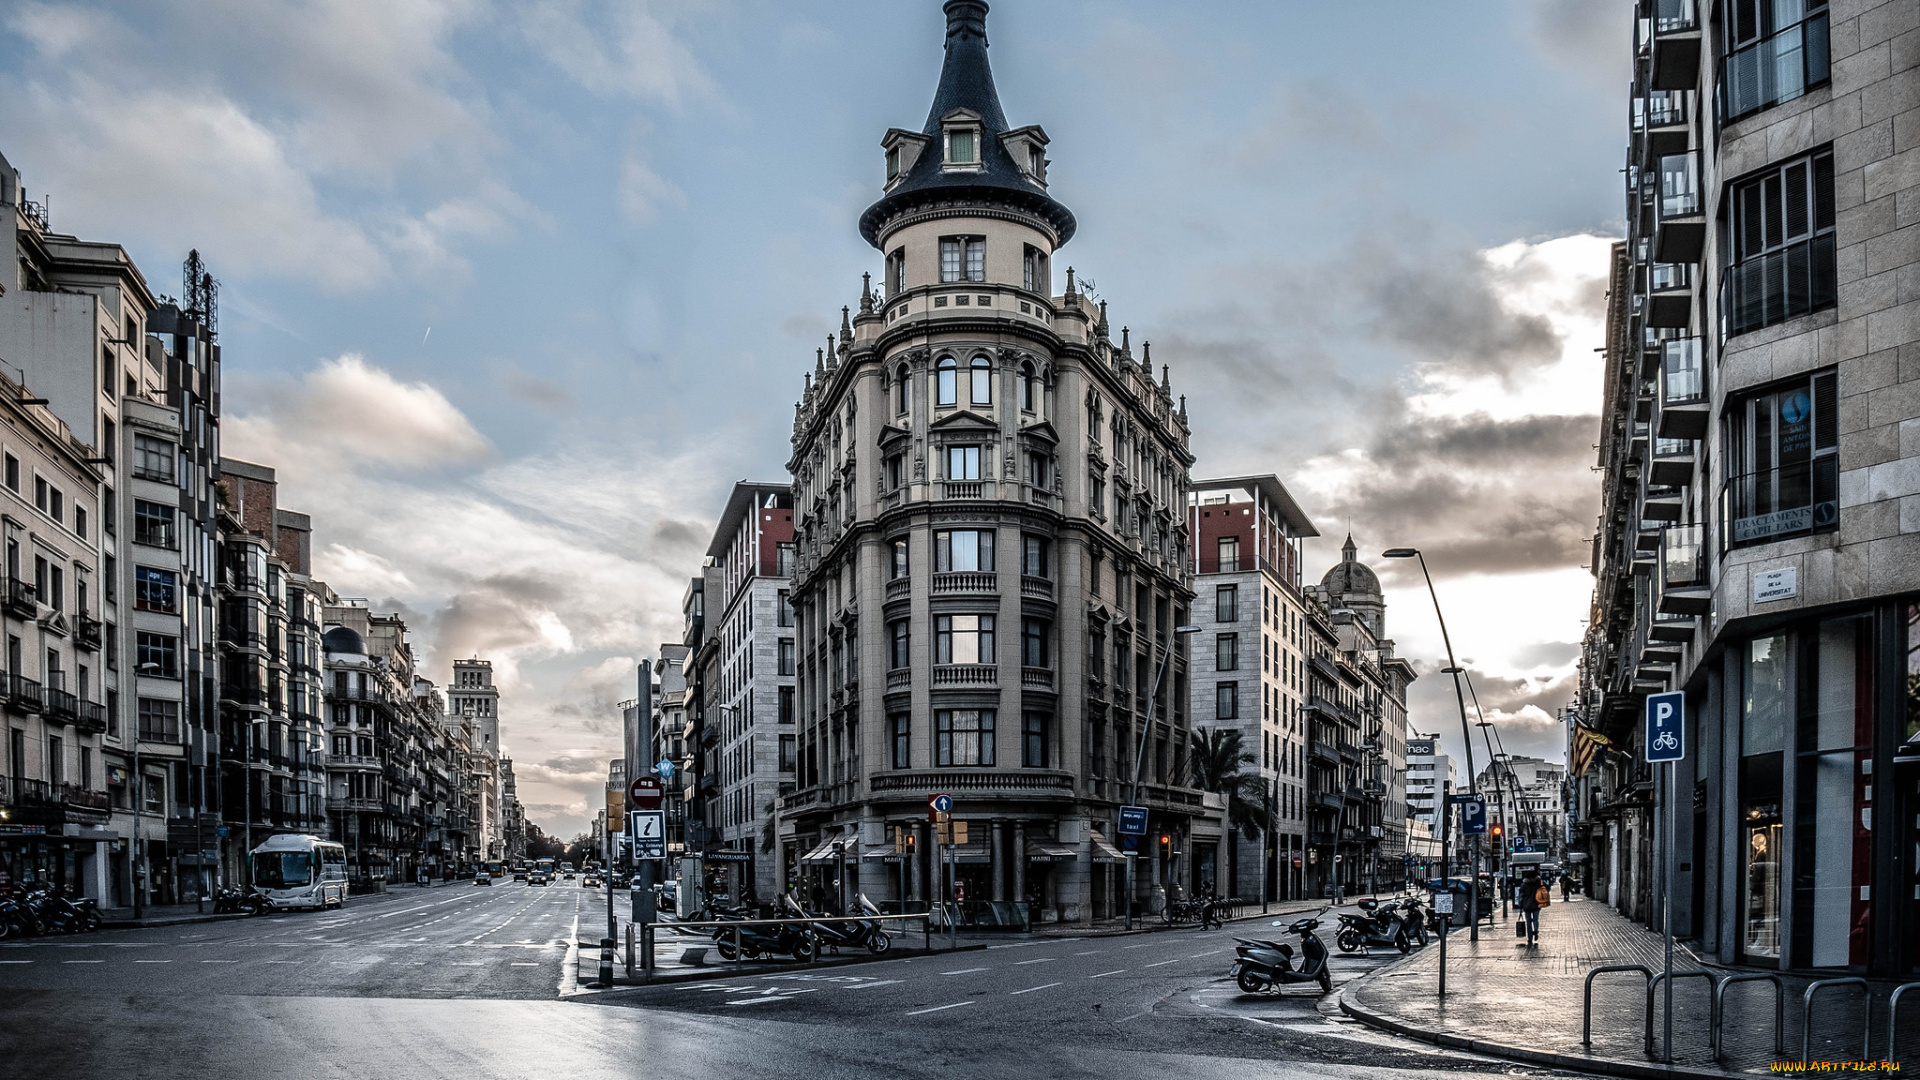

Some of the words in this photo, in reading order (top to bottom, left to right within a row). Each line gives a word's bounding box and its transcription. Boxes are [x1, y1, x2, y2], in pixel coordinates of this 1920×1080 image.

[1735, 507, 1811, 530] TRACTAMENTS
[1758, 587, 1792, 598] UNIVERSITAT
[1657, 702, 1673, 727] P
[1465, 802, 1480, 821] P
[1515, 838, 1523, 846] P
